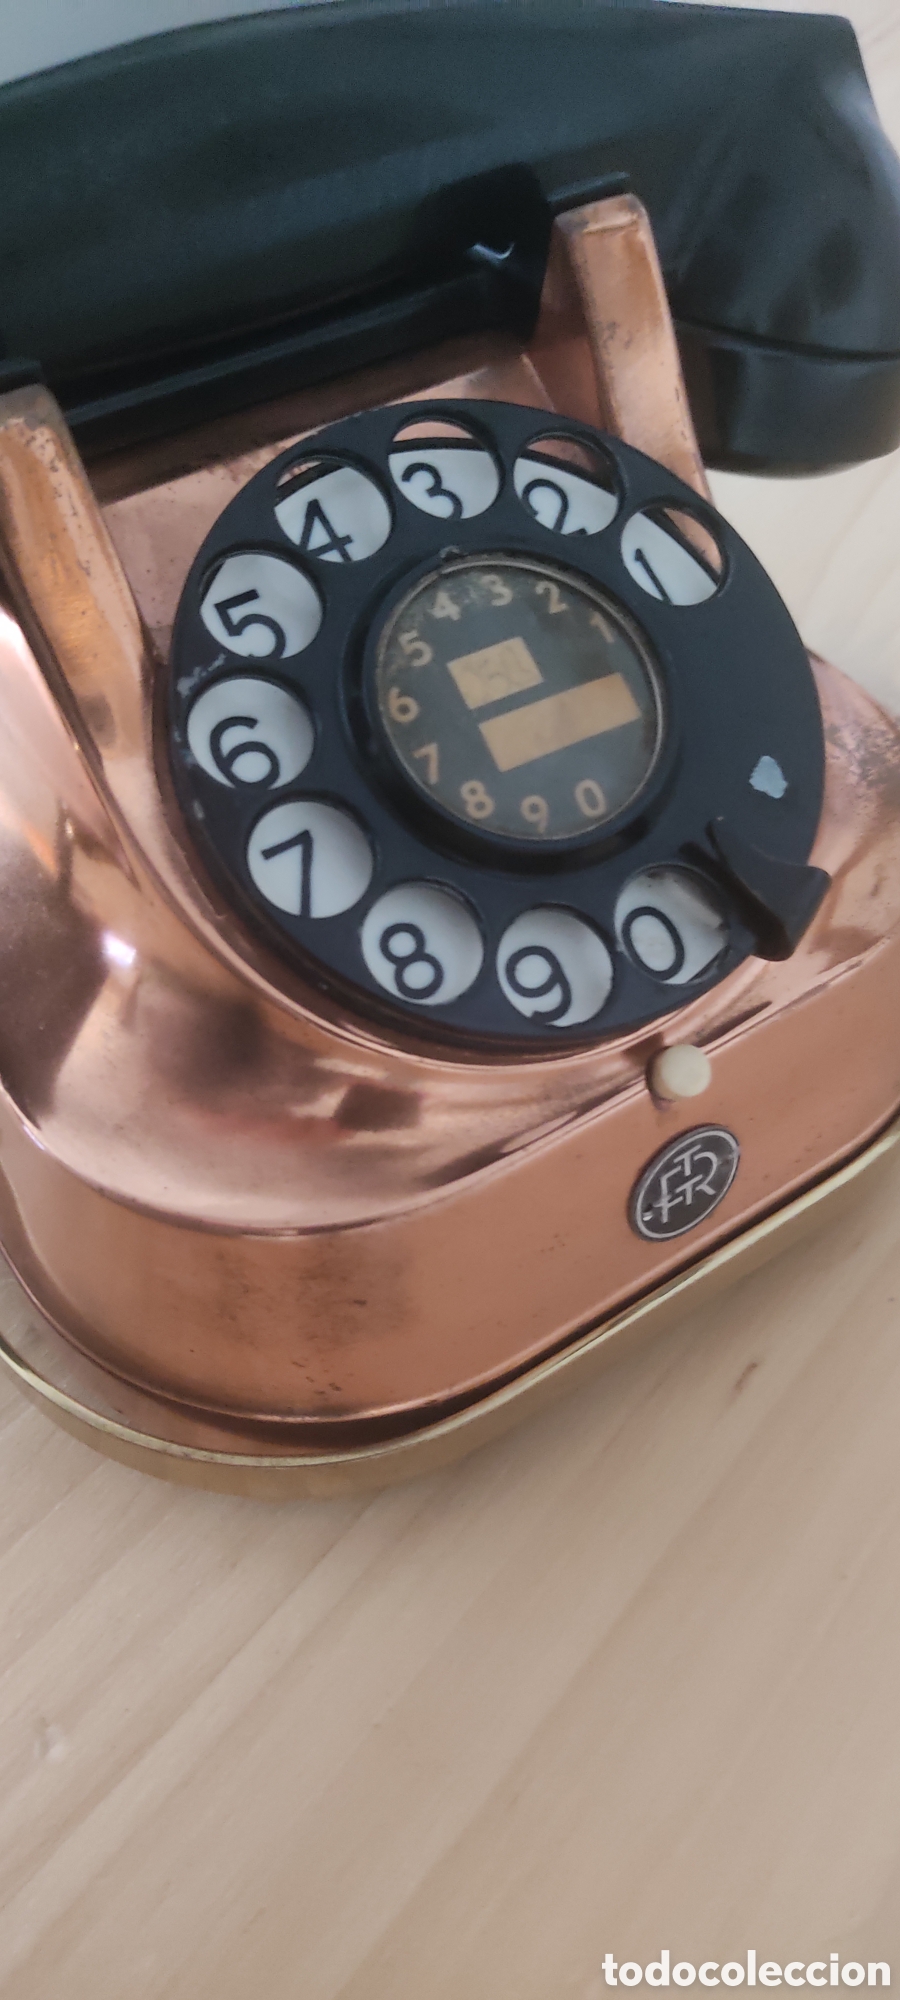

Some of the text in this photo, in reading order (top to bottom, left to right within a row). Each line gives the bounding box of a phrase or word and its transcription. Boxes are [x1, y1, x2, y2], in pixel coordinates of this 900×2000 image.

[402, 462, 464, 520] 3
[521, 478, 587, 536] 2
[299, 498, 354, 563] 4
[481, 574, 513, 606] 3
[535, 581, 569, 614] 2
[634, 548, 674, 605] 1
[213, 588, 286, 660] 5
[428, 591, 461, 621] 4
[590, 611, 615, 643] 1
[400, 630, 432, 666] 5
[388, 687, 420, 723] 6
[209, 715, 281, 788] 6
[413, 742, 439, 784] 7
[460, 780, 494, 819] 8
[520, 795, 549, 834] 9
[574, 779, 606, 819] 0
[261, 829, 314, 919] 7
[379, 922, 444, 1000] 8
[621, 906, 685, 981] 0
[505, 945, 573, 1025] 9
